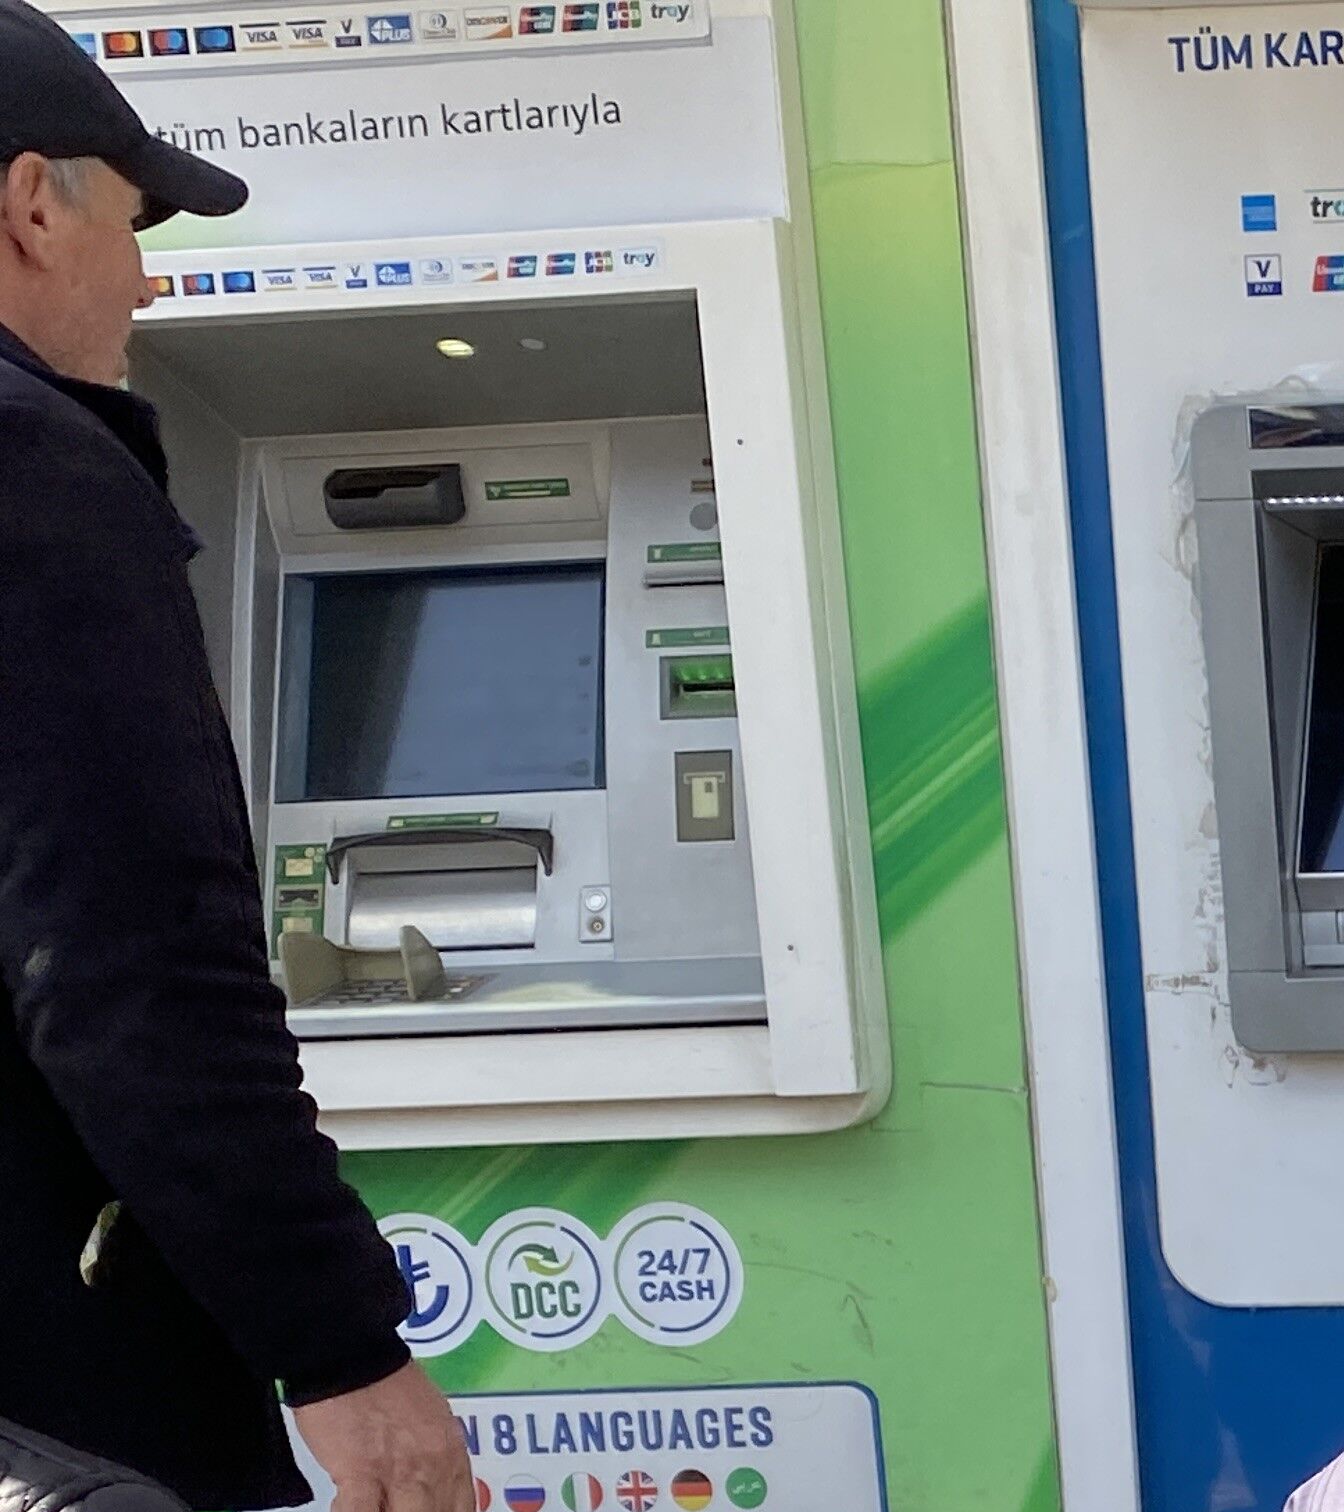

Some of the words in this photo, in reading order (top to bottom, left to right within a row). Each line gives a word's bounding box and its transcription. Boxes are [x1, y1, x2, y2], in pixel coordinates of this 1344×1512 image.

[650, 4, 690, 23] troy
[1167, 27, 1253, 73] TÜM
[237, 108, 428, 149] bankaların
[440, 92, 623, 137] kartlarıyla
[636, 1247, 712, 1278] 24/7
[510, 1281, 582, 1320] DCC
[638, 1279, 716, 1303] CASH
[491, 1413, 518, 1456] 8
[525, 1405, 775, 1455] LANGUAGES
